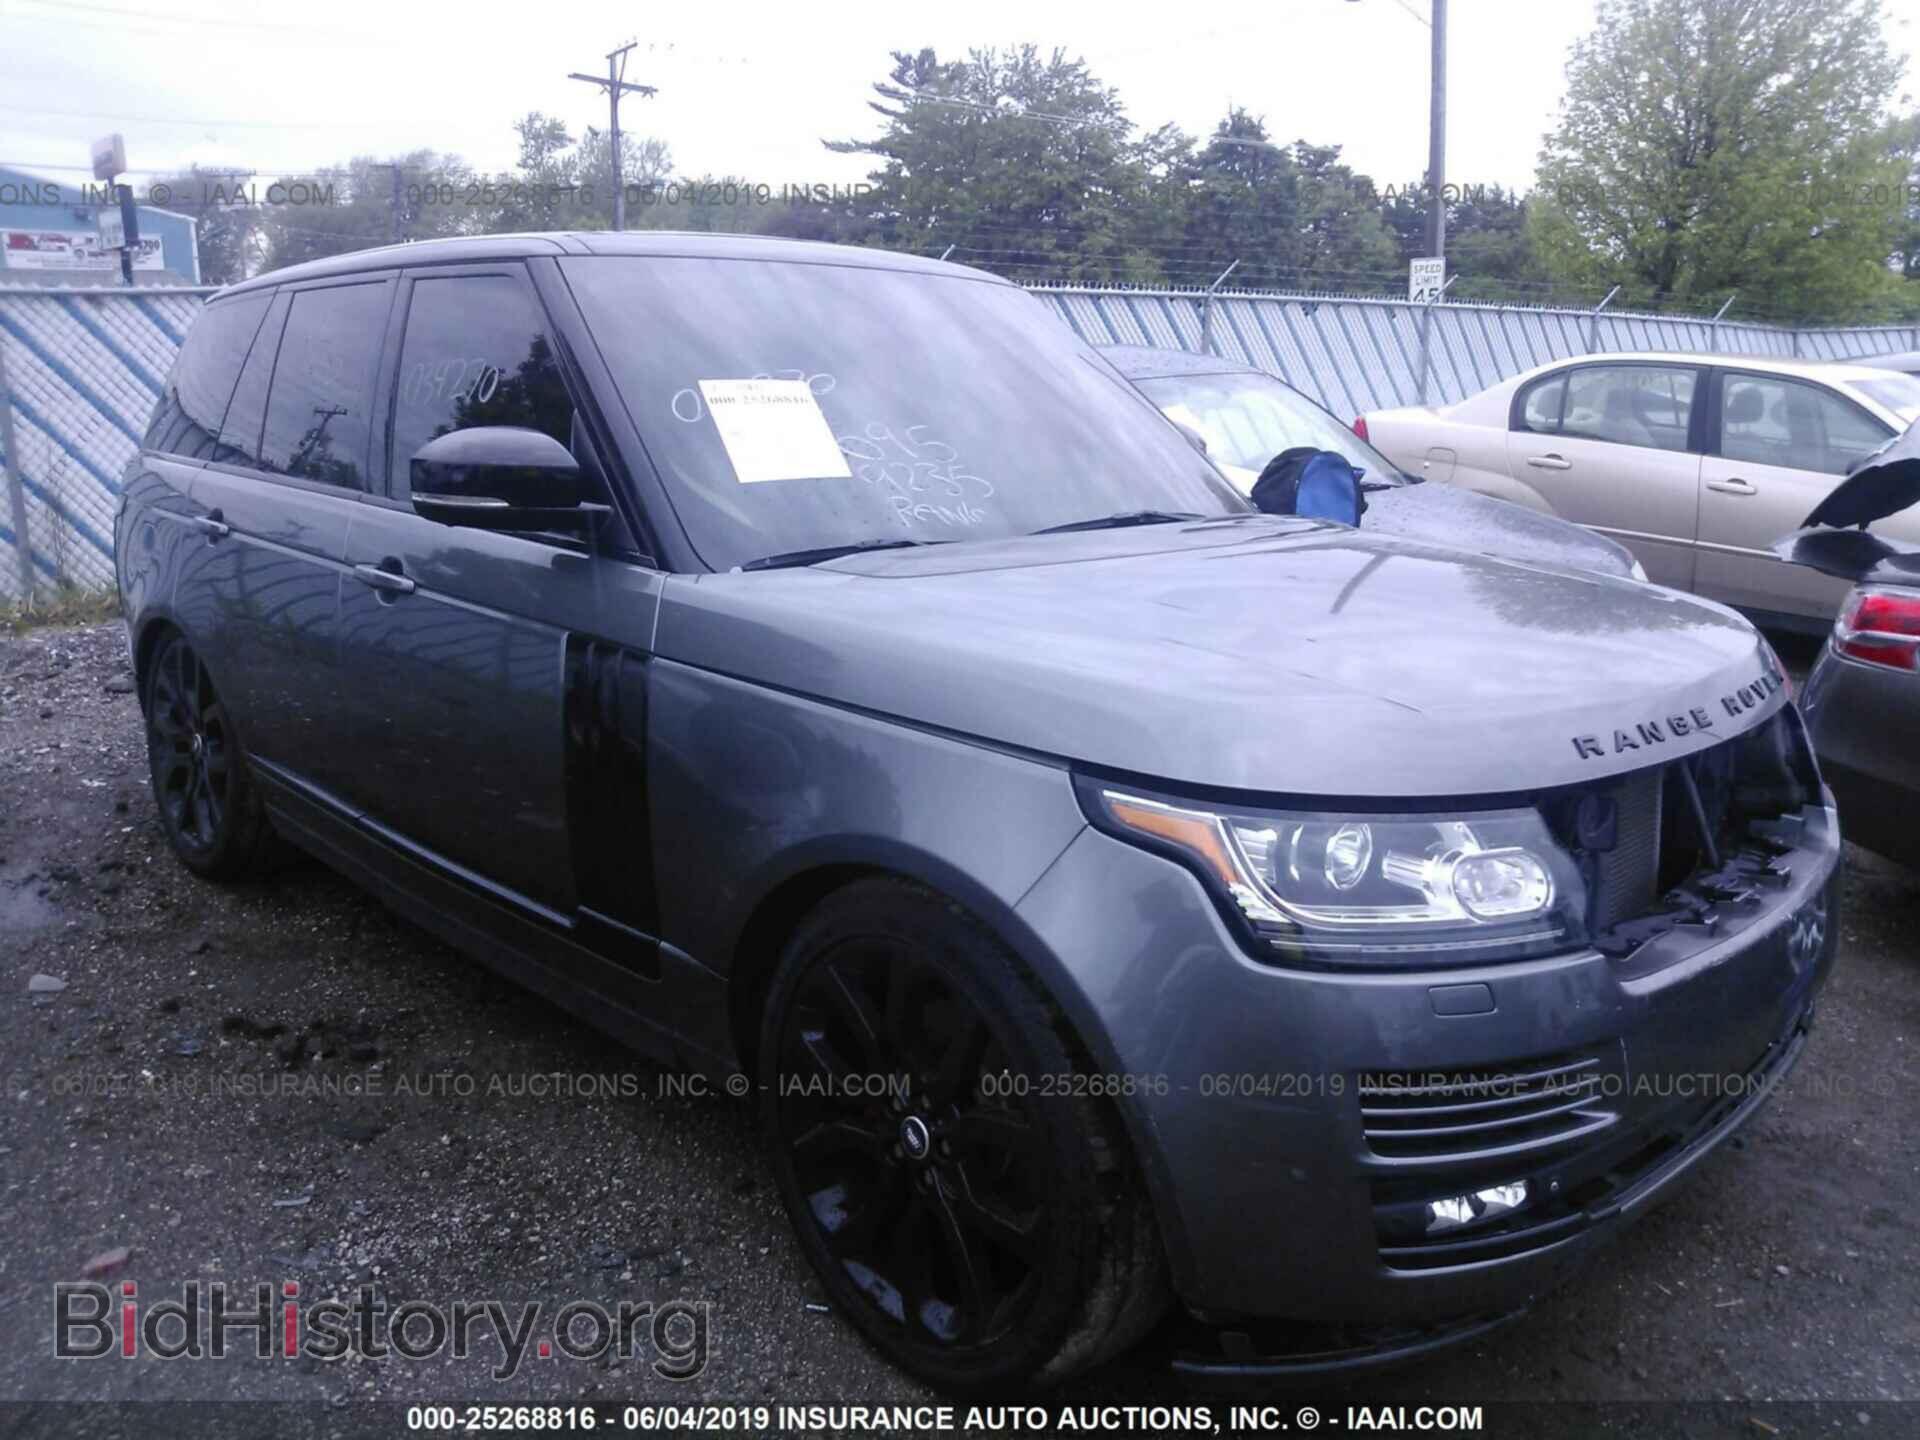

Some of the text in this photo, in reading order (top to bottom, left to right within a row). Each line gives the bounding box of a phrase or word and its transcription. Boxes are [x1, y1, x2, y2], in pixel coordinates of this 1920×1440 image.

[1414, 263, 1442, 274] SPEED
[1415, 275, 1439, 286] LIMIT
[1571, 707, 1713, 760] RANGE
